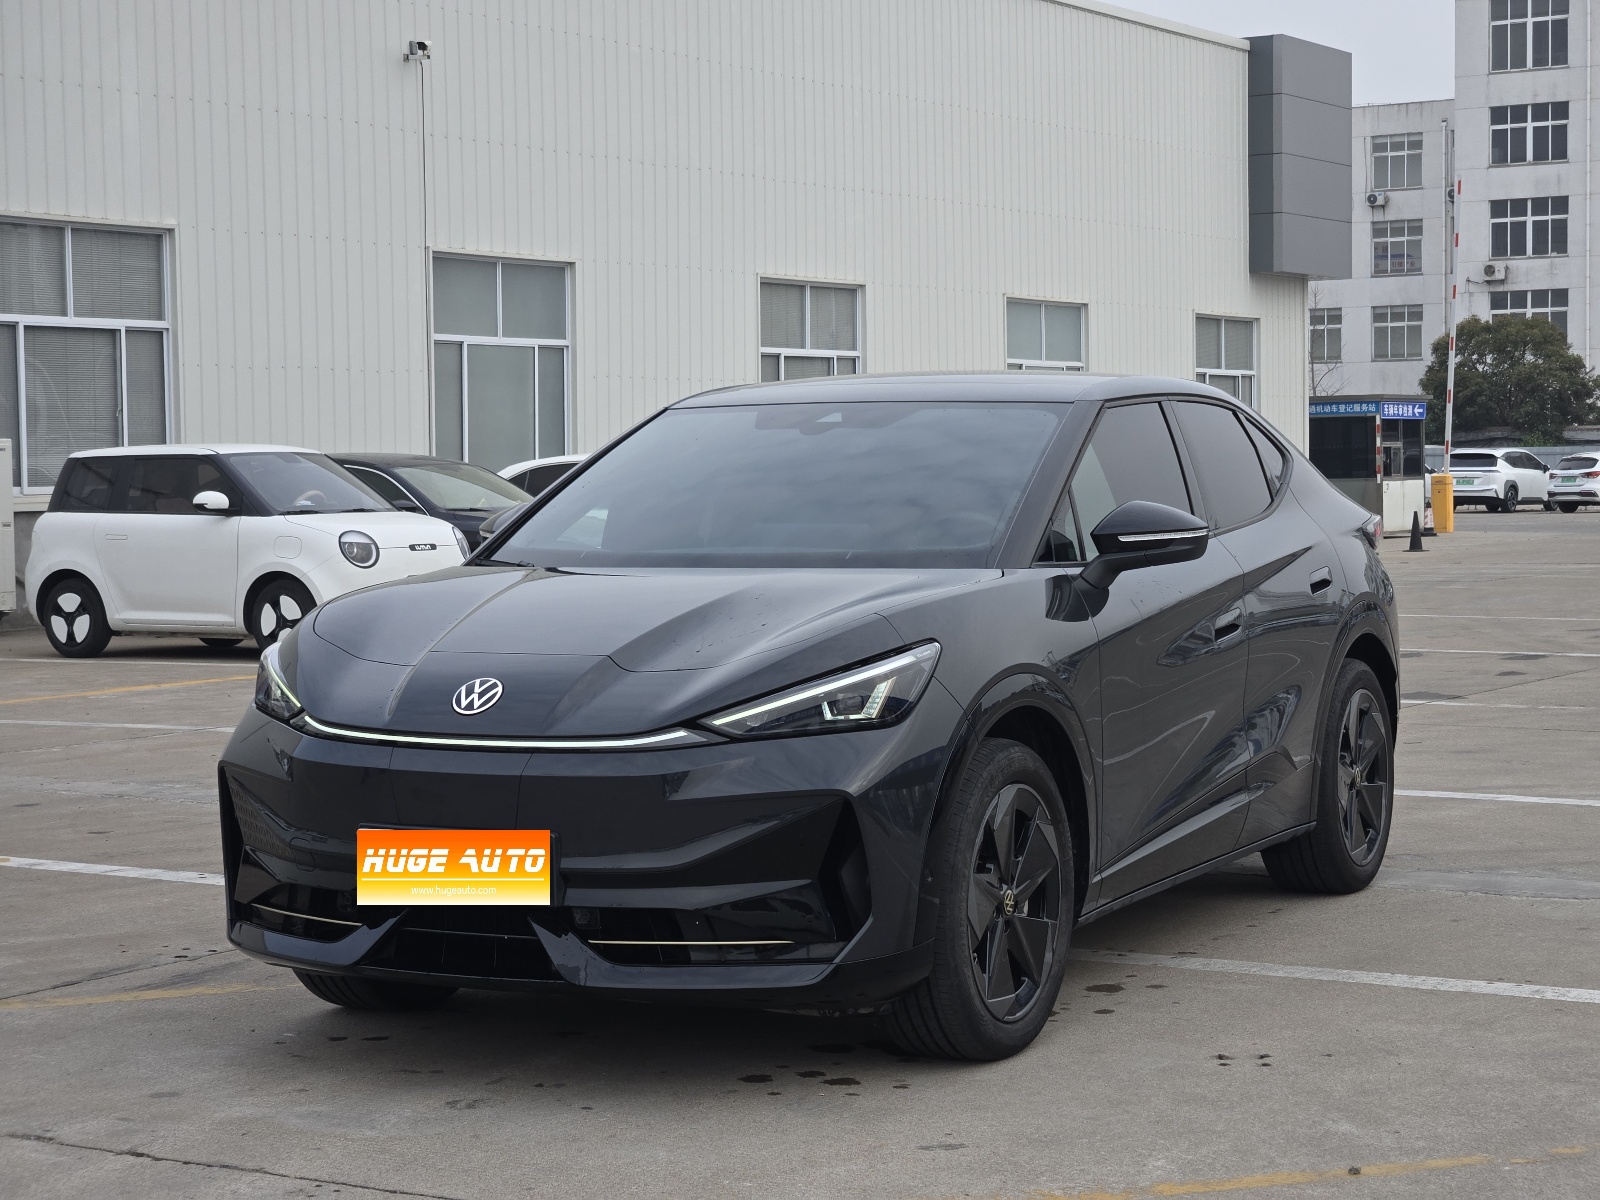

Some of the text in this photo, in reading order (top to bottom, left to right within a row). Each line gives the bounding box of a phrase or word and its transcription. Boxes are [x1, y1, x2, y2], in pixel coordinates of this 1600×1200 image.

[1383, 404, 1413, 417] 车辆年审检测
